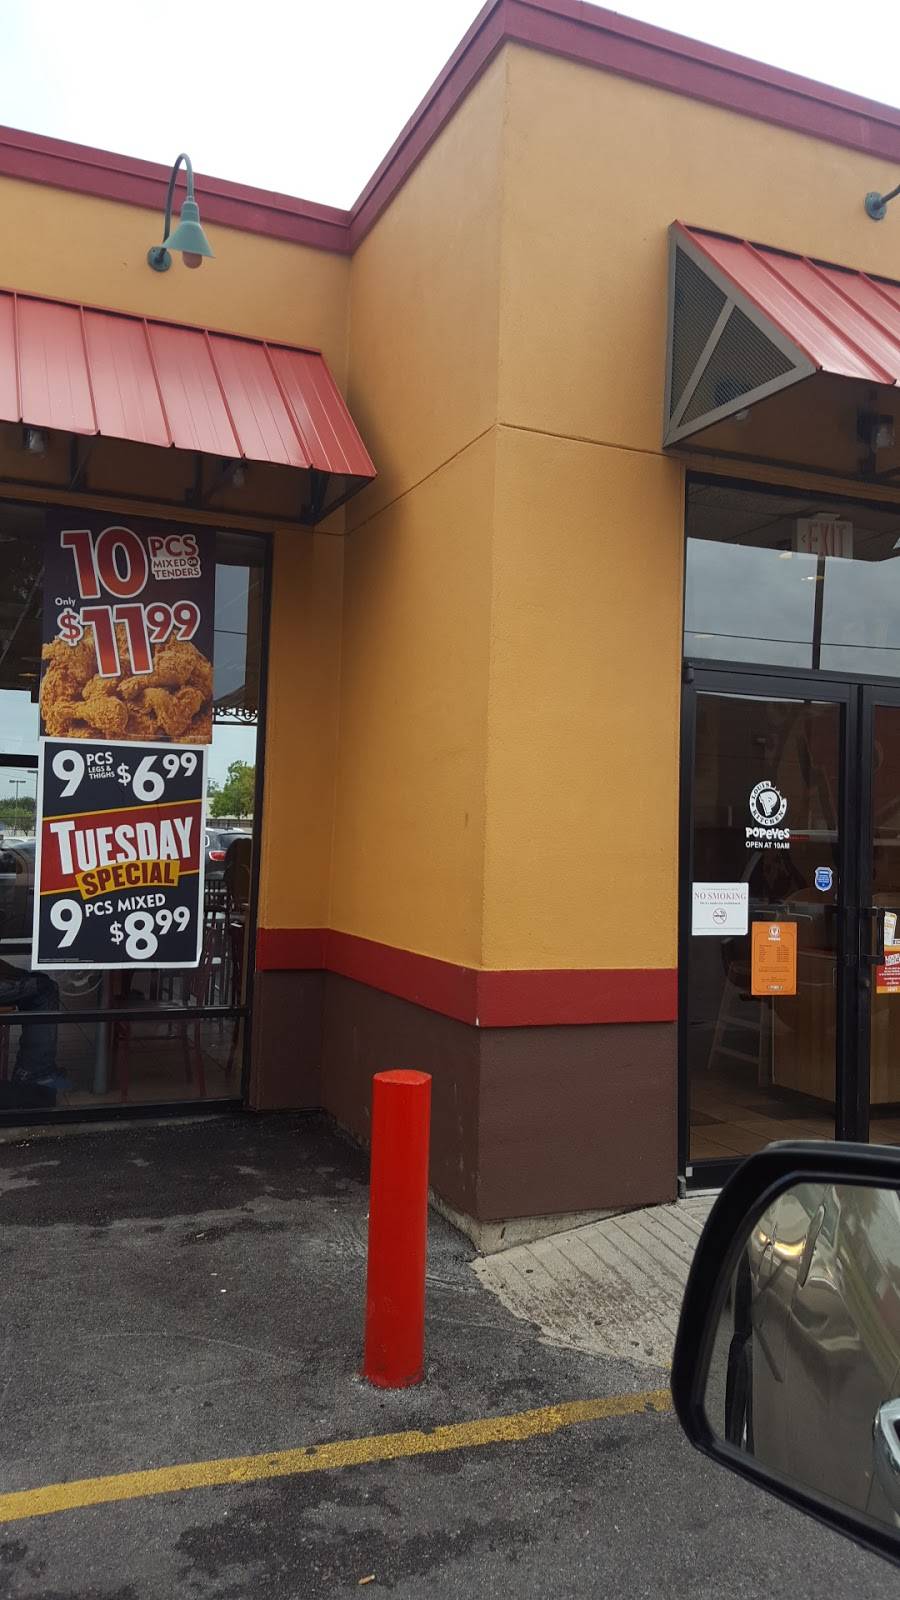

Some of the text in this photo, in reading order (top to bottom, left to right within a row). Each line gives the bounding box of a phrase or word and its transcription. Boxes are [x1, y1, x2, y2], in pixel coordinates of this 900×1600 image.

[148, 534, 199, 558] PCS
[807, 521, 849, 558] EXIT
[60, 526, 148, 599] 10
[153, 559, 187, 569] MIXED
[153, 567, 200, 578] TENDERS
[55, 597, 76, 606] Only
[86, 752, 113, 766] PCS
[88, 765, 105, 773] LEGS
[52, 749, 84, 798] 9
[88, 771, 116, 780] THIGHS
[752, 809, 784, 825] KITCHEN
[50, 816, 193, 875] TUESDAY
[81, 862, 175, 896] SPECIAL
[85, 893, 166, 917] PCS MIXED
[694, 892, 747, 901] NO SMOKING
[50, 899, 83, 948] 9
